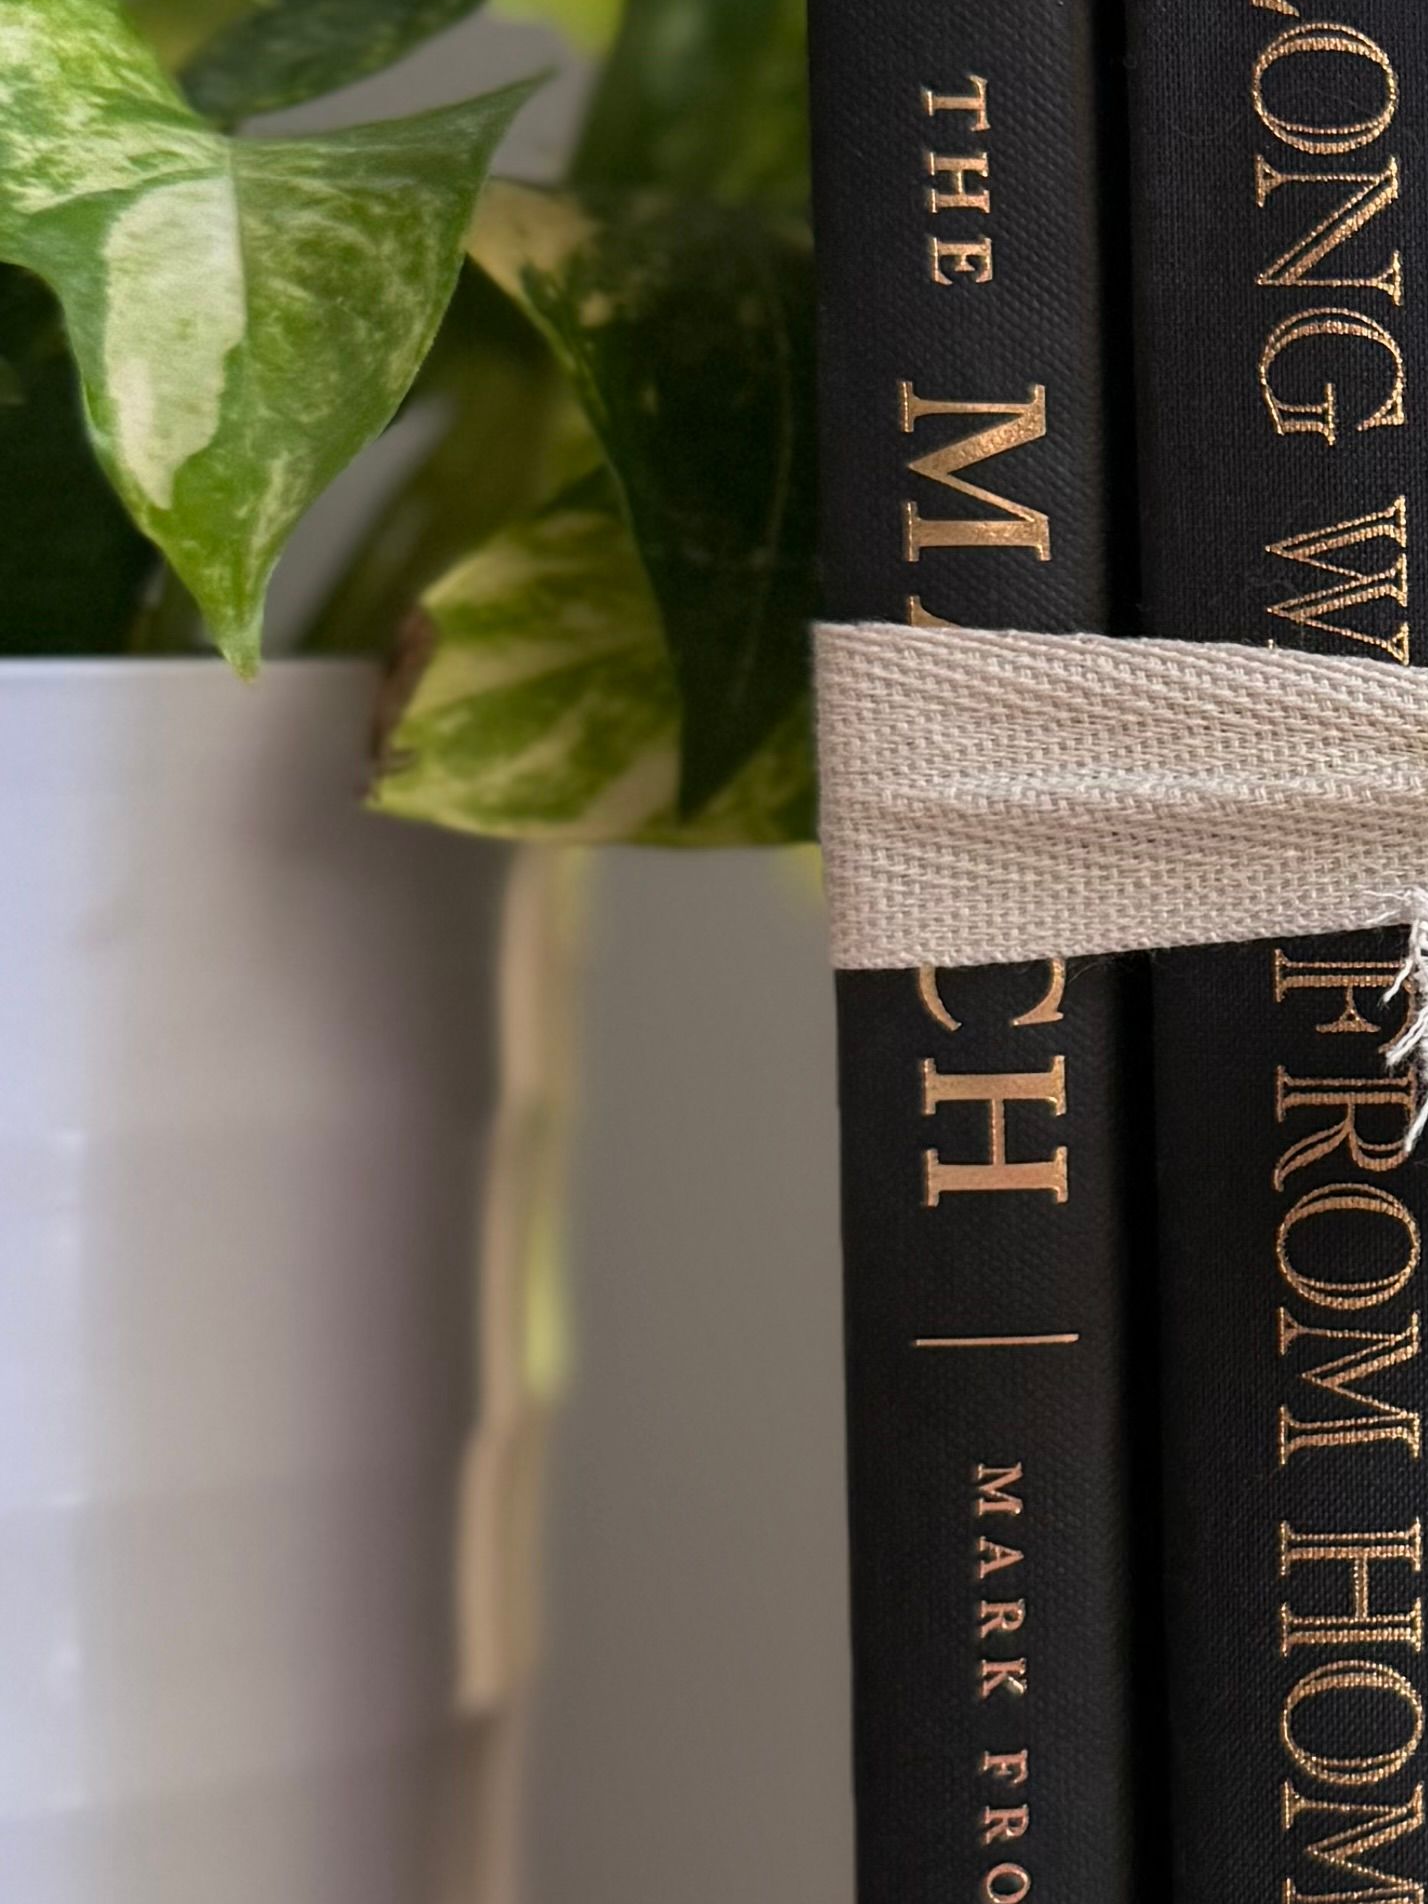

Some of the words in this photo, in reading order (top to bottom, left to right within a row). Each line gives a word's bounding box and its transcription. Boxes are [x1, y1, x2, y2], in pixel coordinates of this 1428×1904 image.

[919, 75, 993, 287] THE
[1272, 948, 1422, 1464] FROM
[974, 1462, 1026, 1700] MARK
